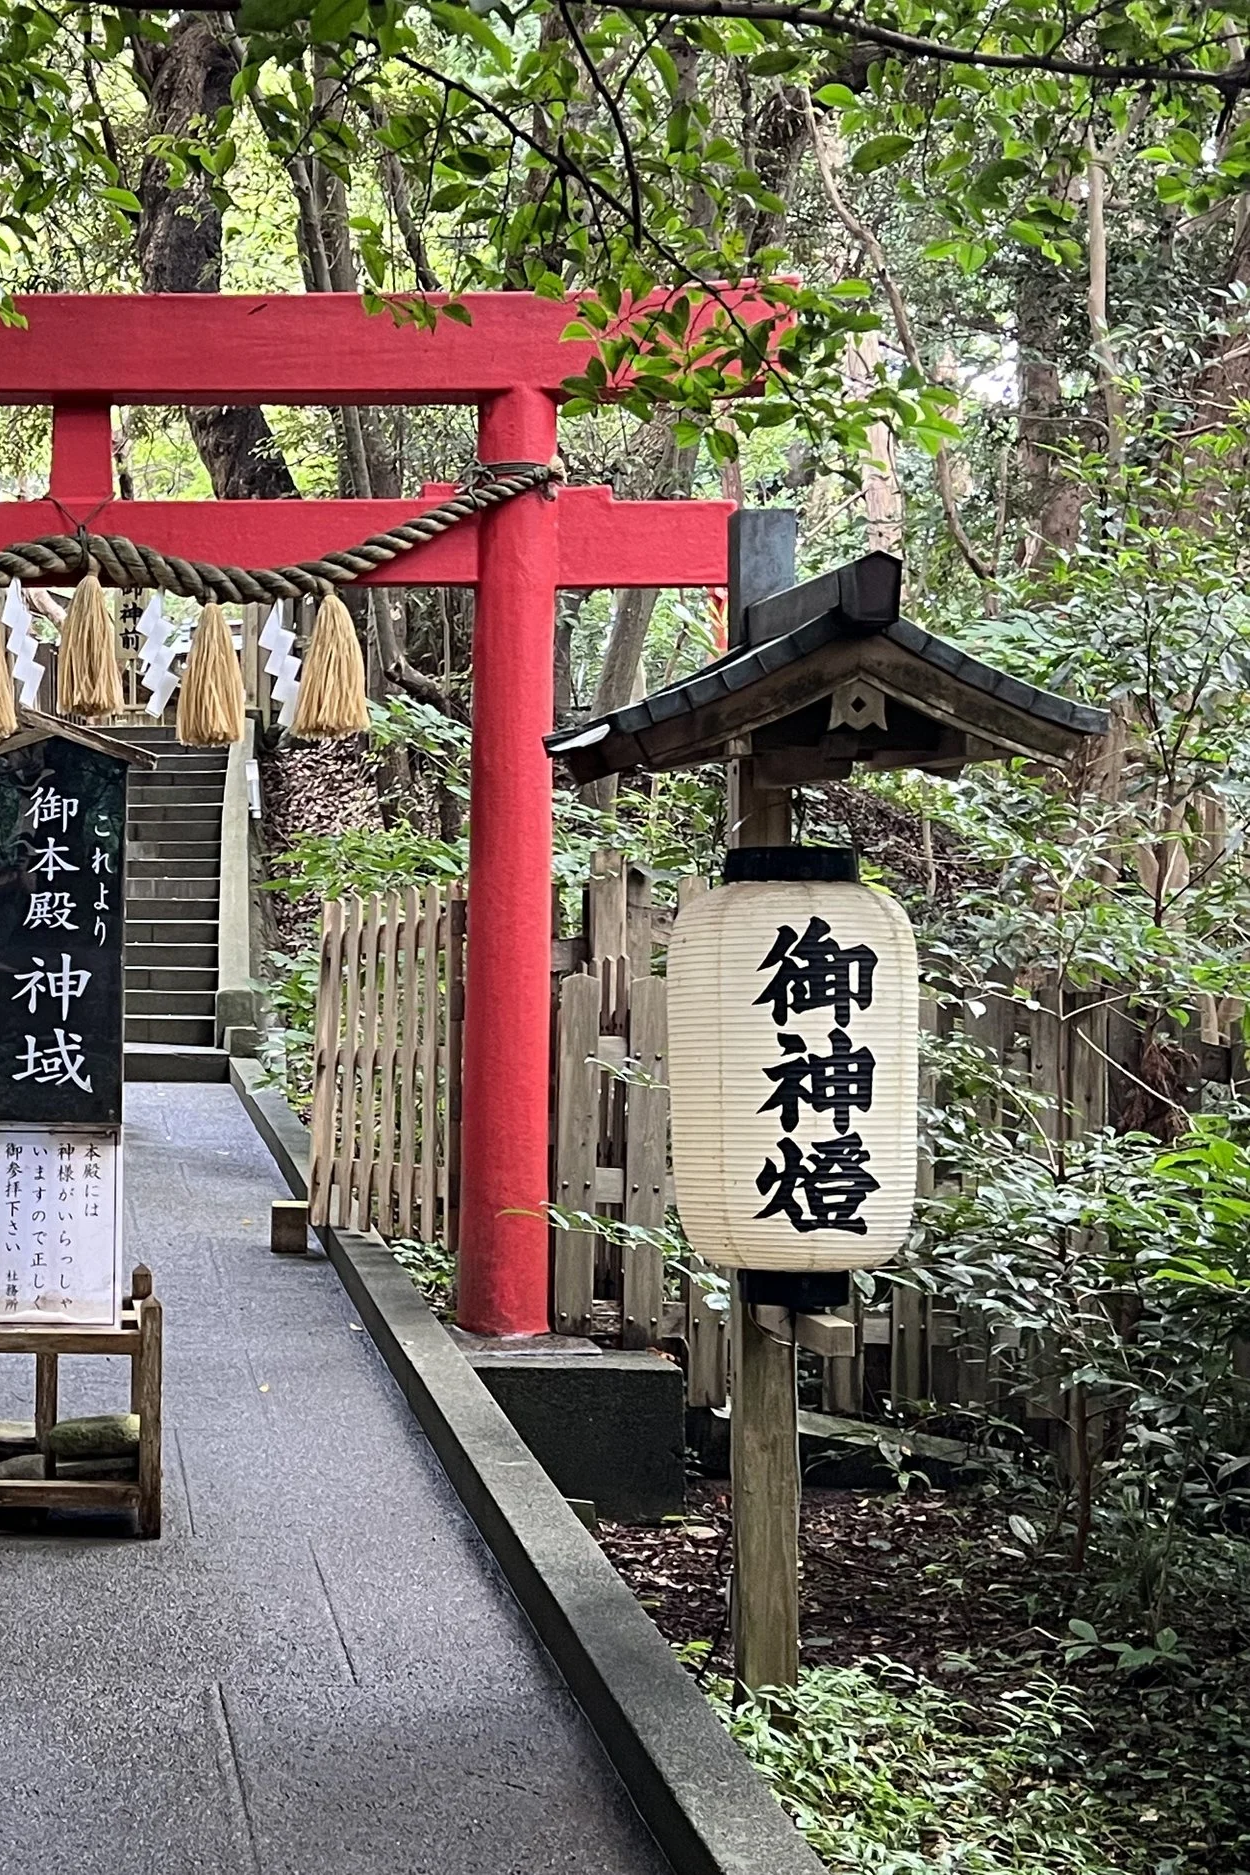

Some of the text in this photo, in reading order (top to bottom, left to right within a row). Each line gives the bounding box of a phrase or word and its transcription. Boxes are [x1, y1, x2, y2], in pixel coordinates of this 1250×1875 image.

[91, 814, 114, 947] これより
[752, 916, 881, 1235] 御神燈
[4, 1142, 23, 1252] 御参拝下さい
[30, 1145, 48, 1311] いますので正しく
[56, 1142, 76, 1309] 神様がいらっしゃ
[82, 1142, 102, 1218] 本殿には
